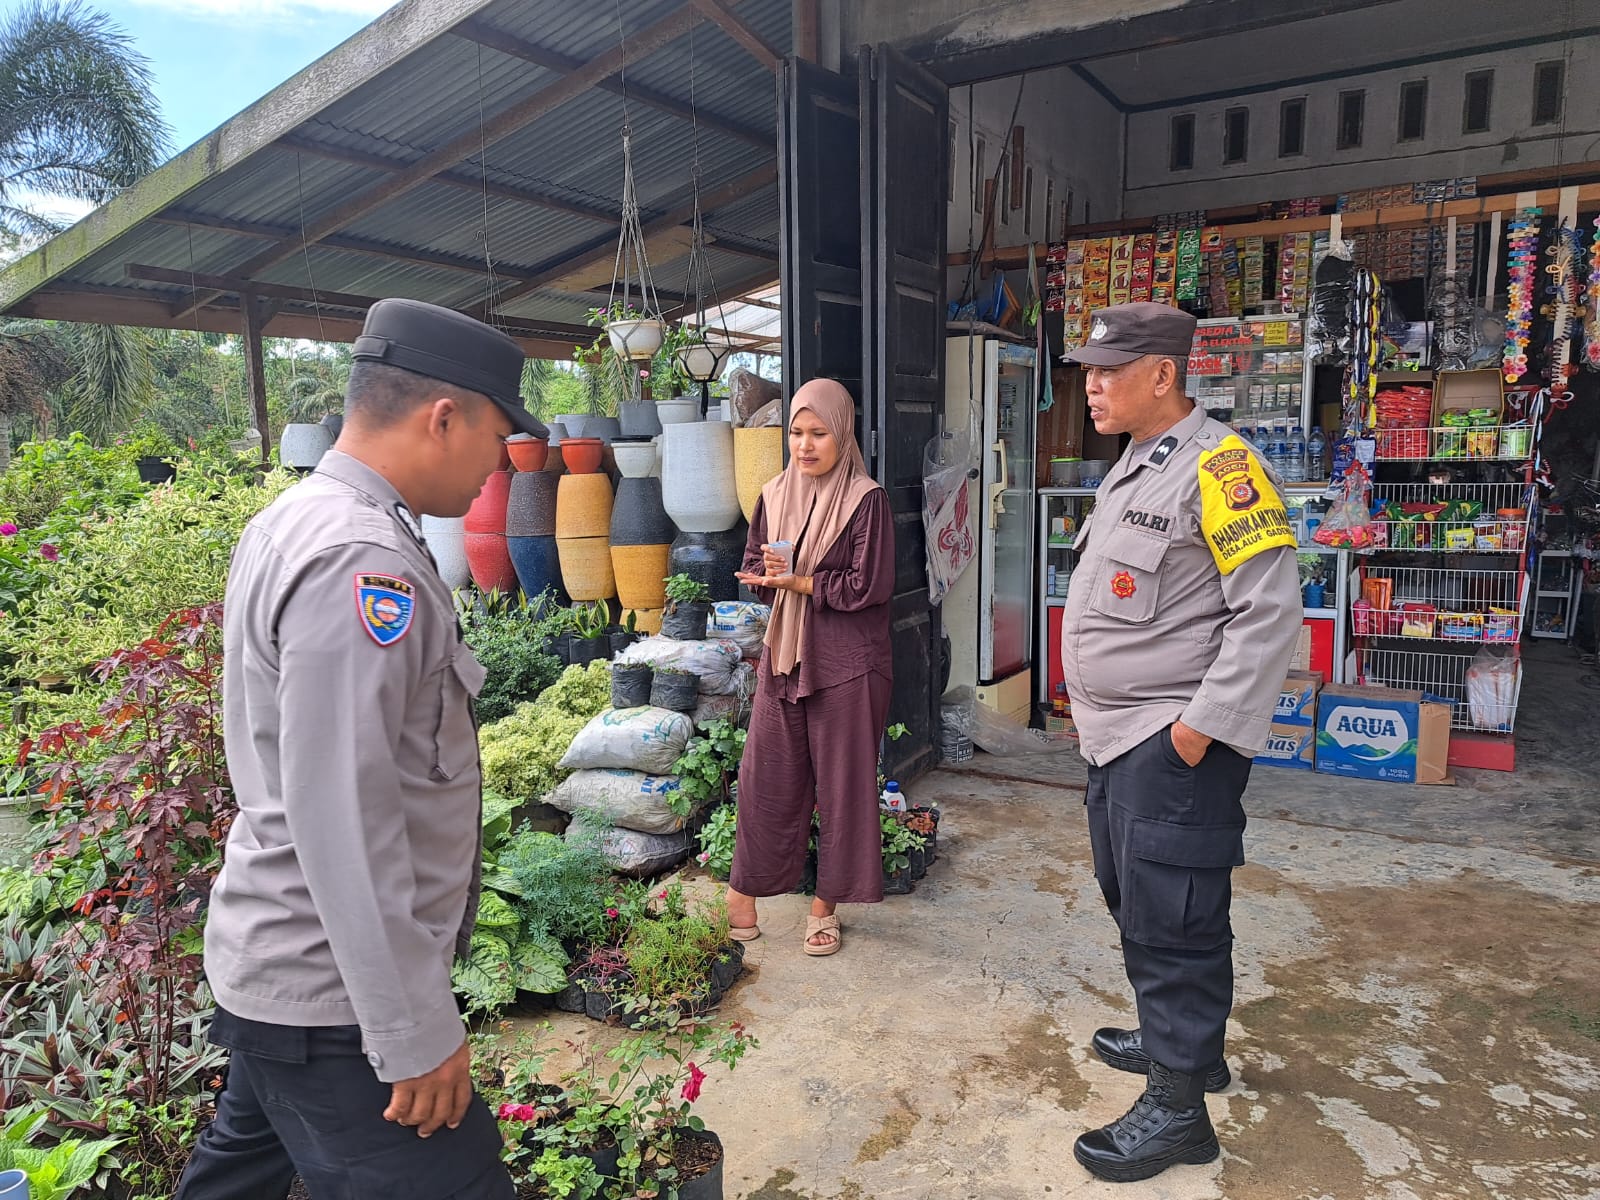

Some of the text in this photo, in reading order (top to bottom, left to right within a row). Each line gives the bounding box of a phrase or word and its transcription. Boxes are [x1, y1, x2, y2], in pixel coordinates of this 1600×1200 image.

[1218, 463, 1246, 477] ACEH
[1122, 509, 1170, 533] POLRI
[1336, 715, 1397, 738] AQUA
